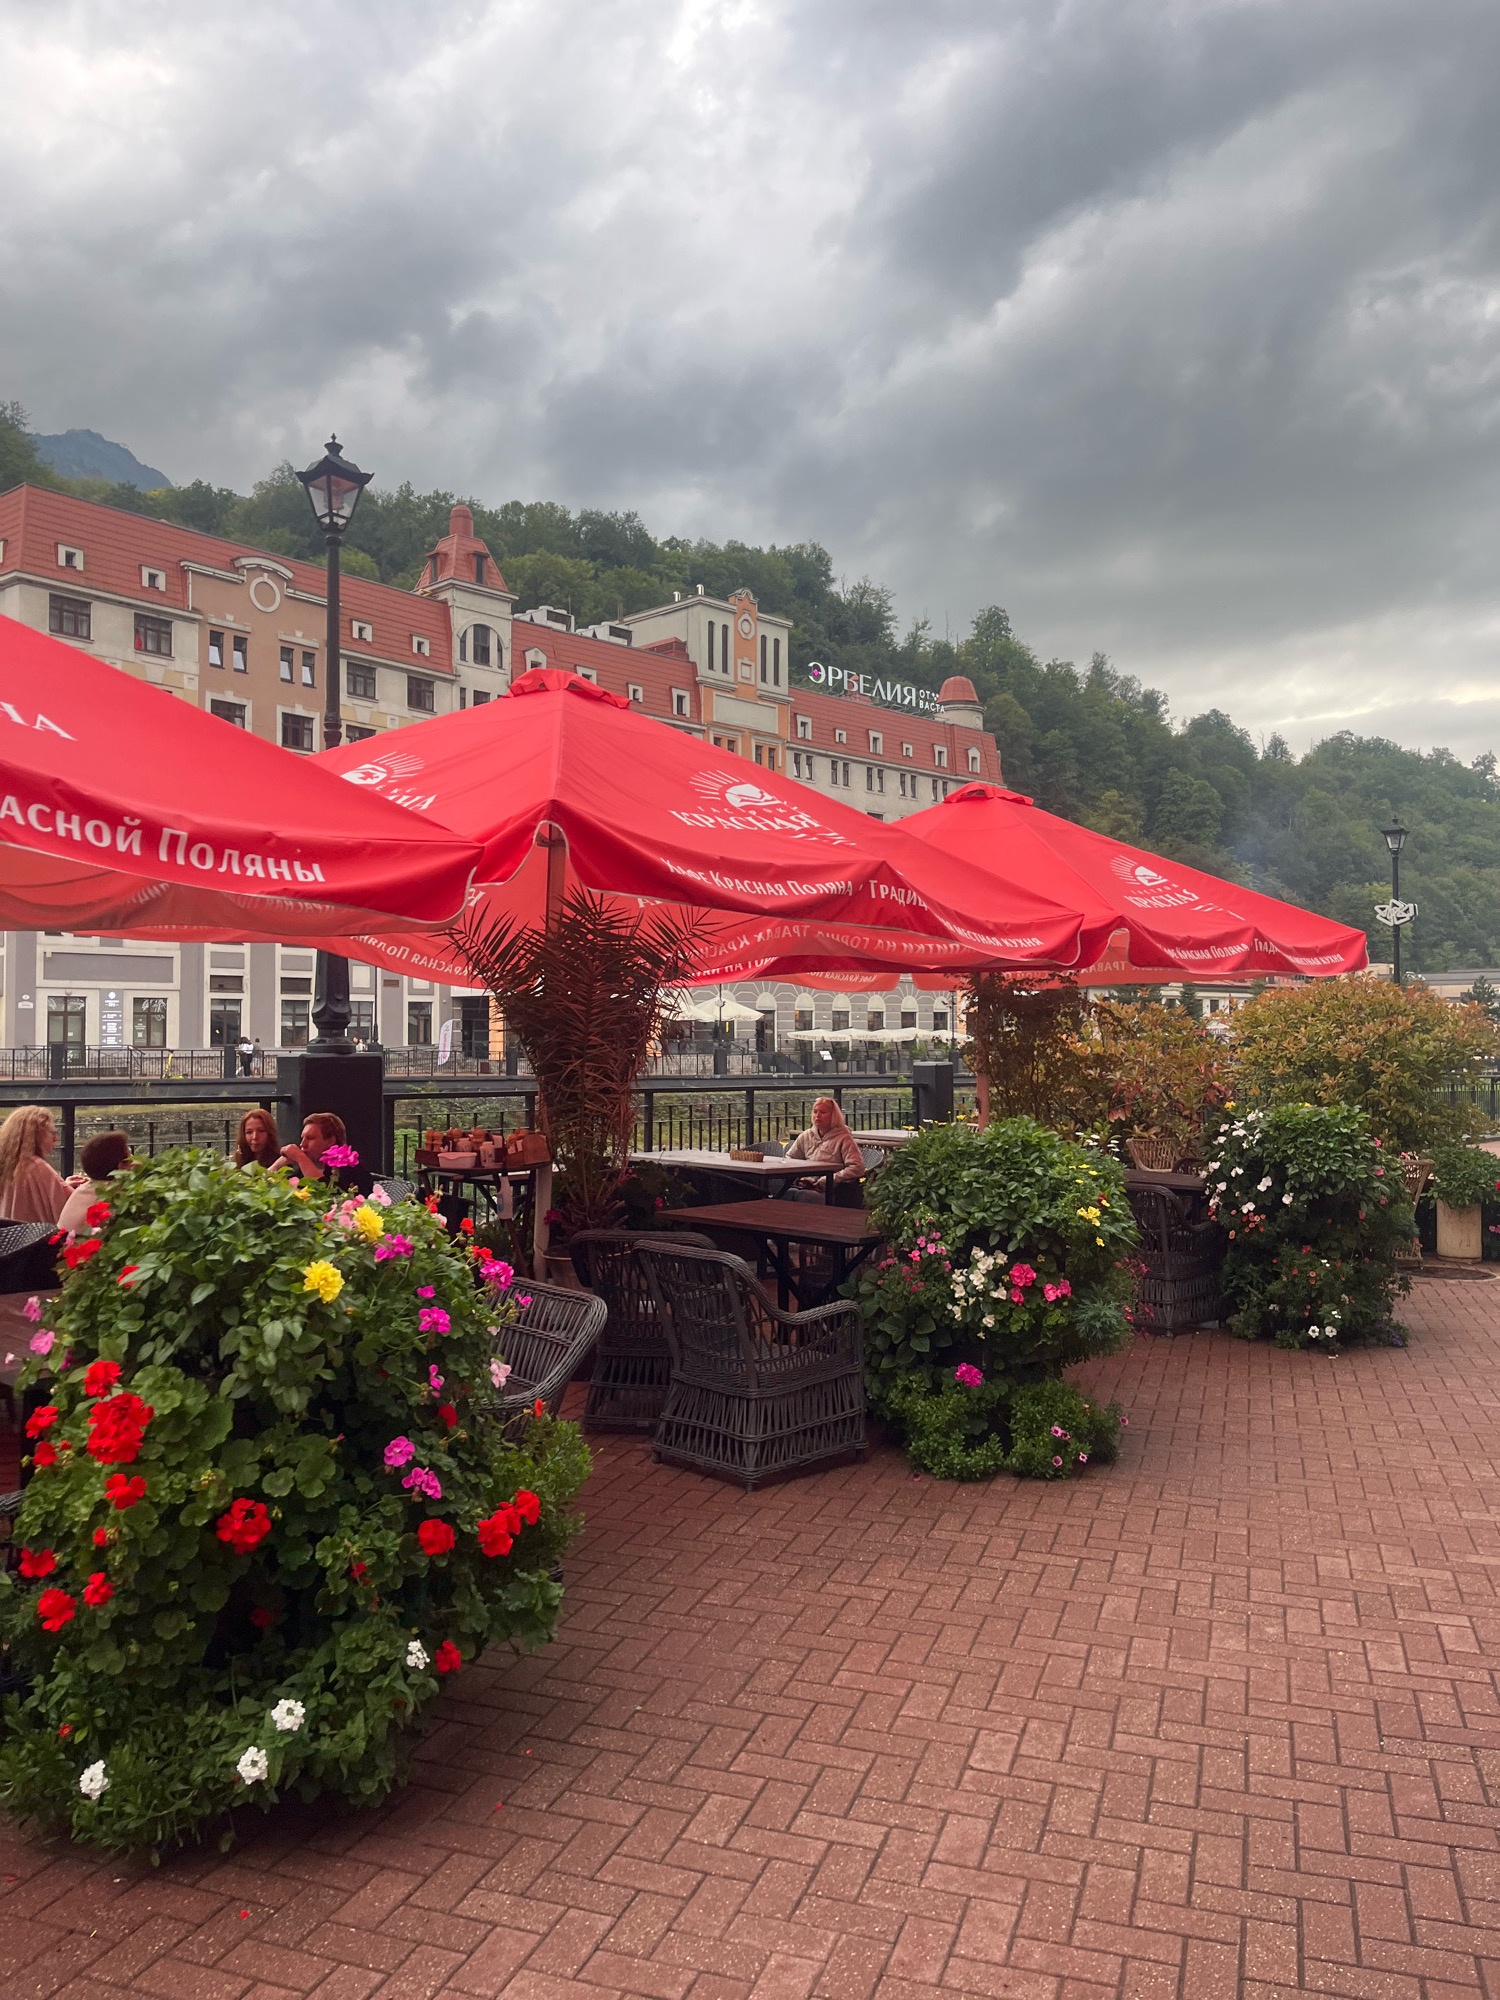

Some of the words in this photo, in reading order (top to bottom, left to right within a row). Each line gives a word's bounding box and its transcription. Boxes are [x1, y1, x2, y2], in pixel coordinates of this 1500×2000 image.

[807, 661, 917, 707] ЭРБЕЛИЯ
[919, 700, 945, 713] ВАСТА
[709, 870, 788, 896] КРАСНАЯ
[786, 879, 853, 896] ПОЛЯНА
[1001, 937, 1044, 948] КУХНЯ
